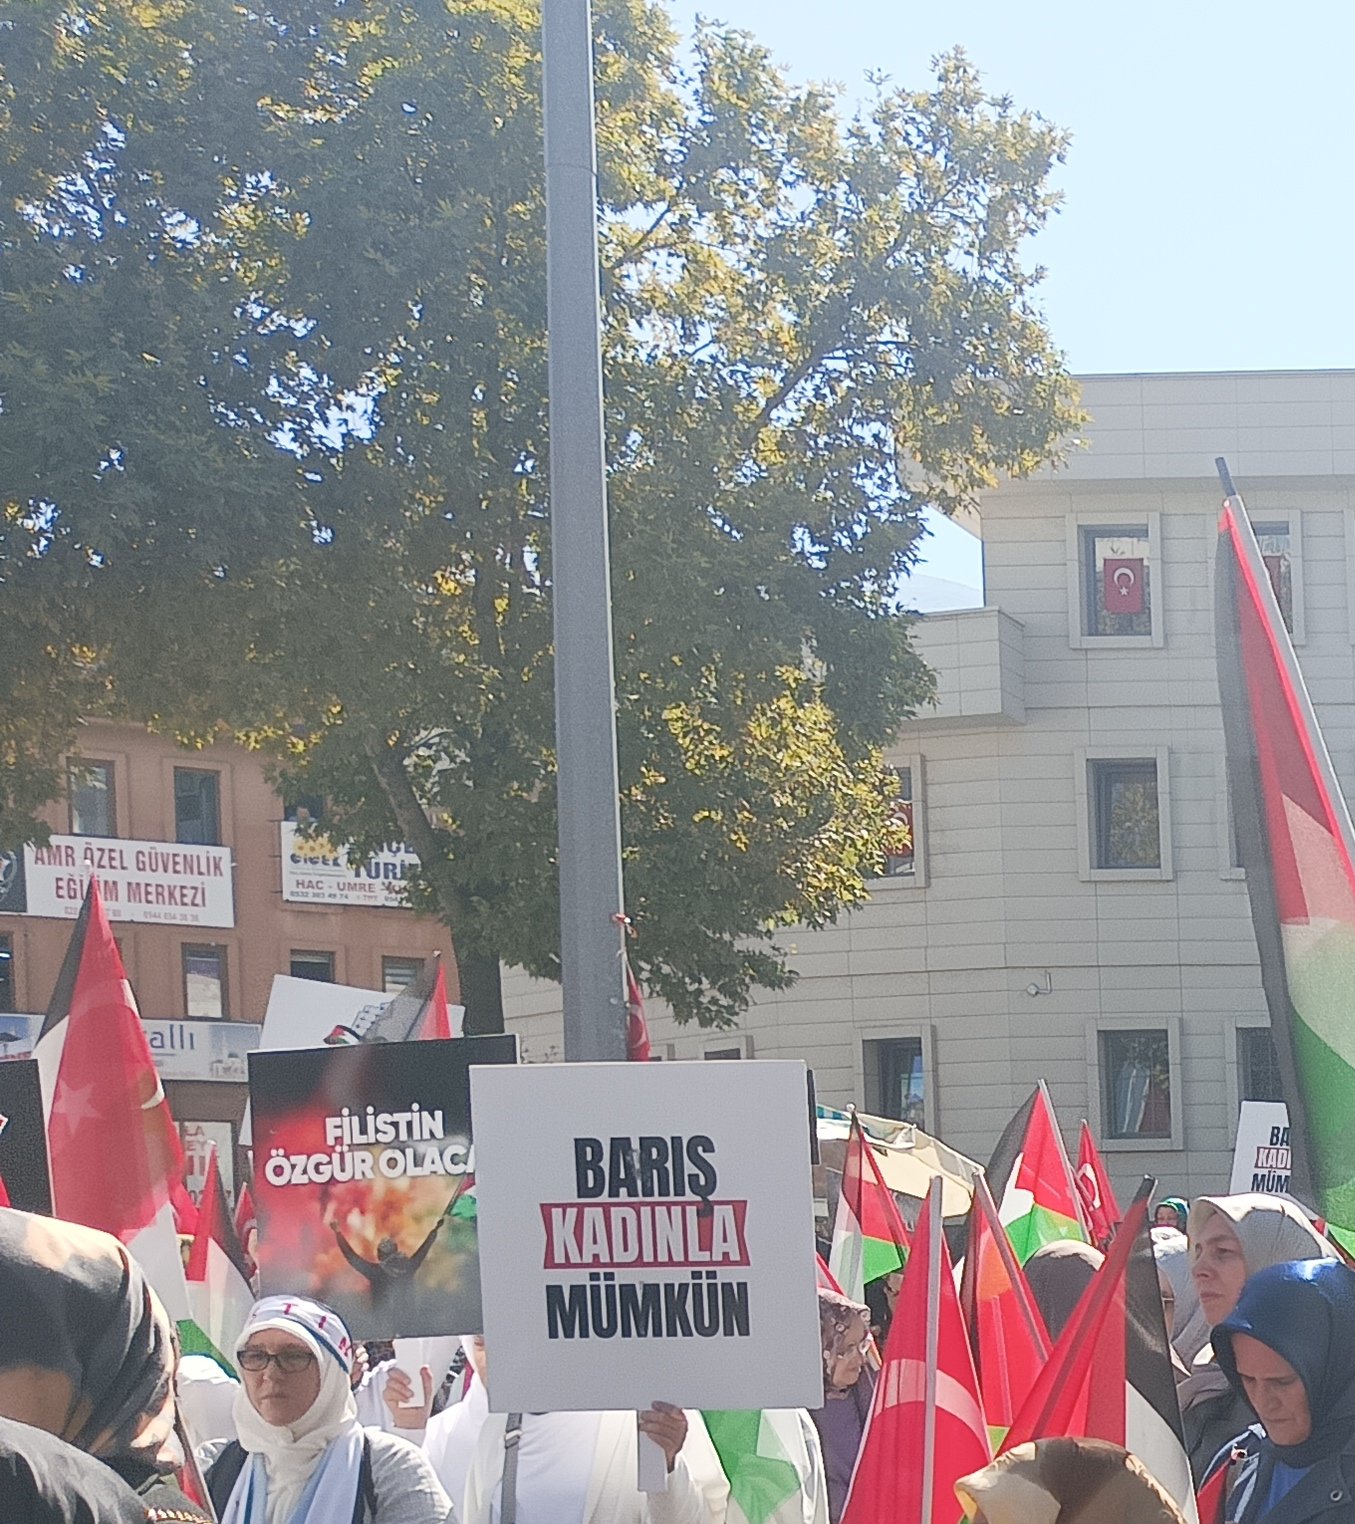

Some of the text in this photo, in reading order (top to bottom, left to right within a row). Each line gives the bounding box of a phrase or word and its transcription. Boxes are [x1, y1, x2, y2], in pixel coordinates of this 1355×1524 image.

[83, 842, 128, 870] ÖZEL
[135, 847, 224, 877] GÜVENLİK
[127, 881, 206, 908] MERKEZİ
[325, 1102, 445, 1146] FİLİSTİN
[265, 1145, 375, 1187] ÖZGÜR
[573, 1135, 718, 1217] BARIŞ
[1252, 1170, 1290, 1192] MÜM
[551, 1205, 741, 1264] KADINLA
[545, 1270, 750, 1339] MÜMKÜN
